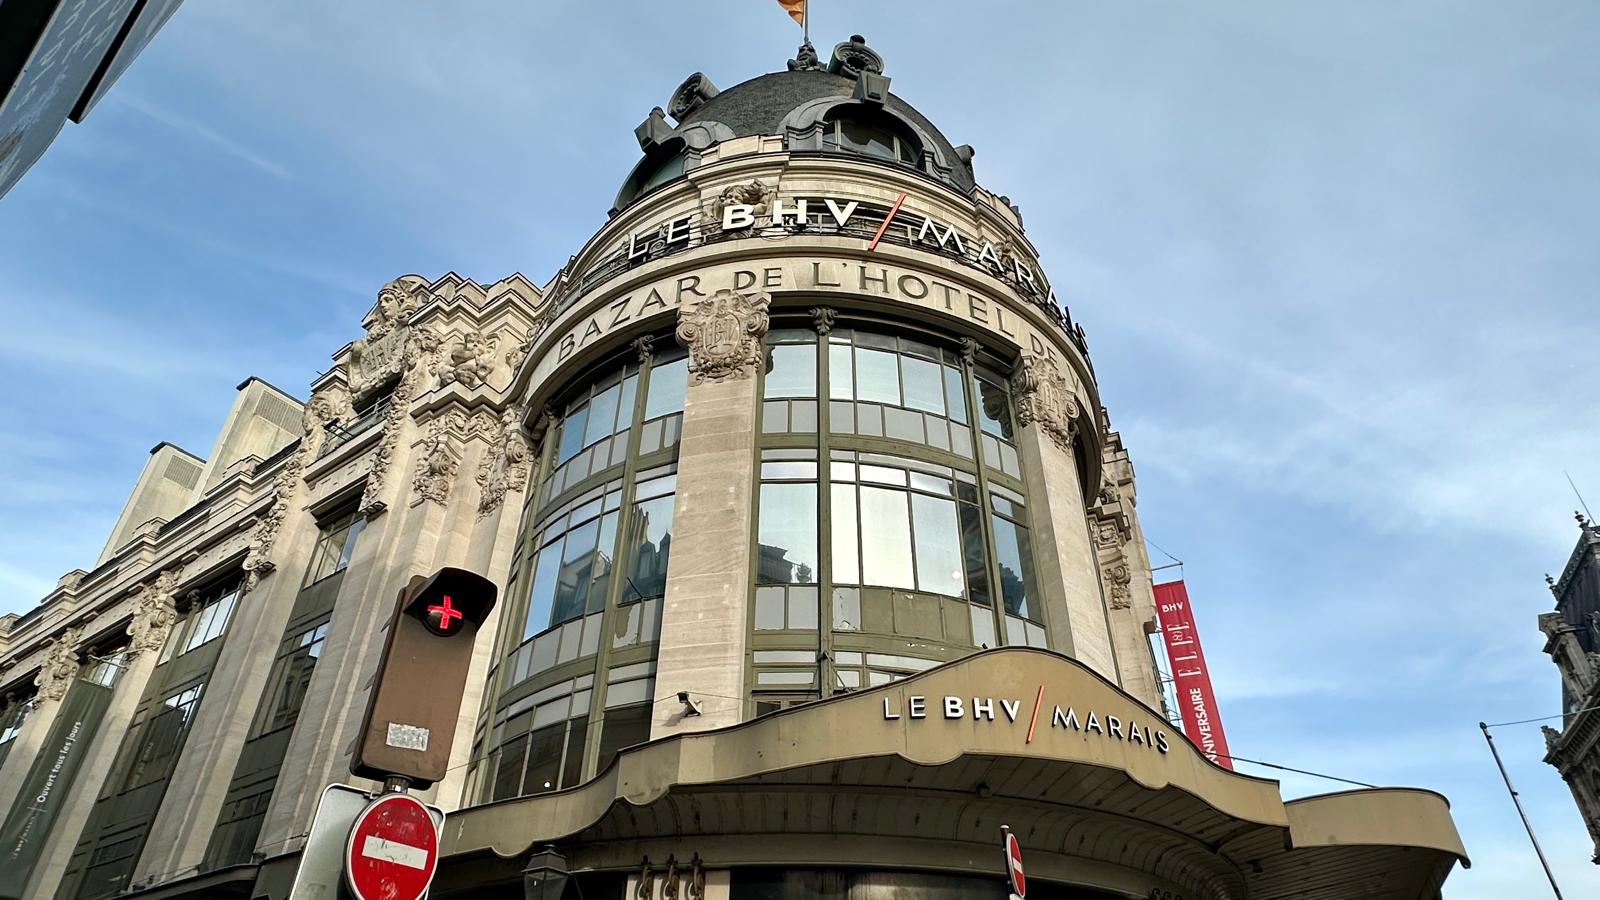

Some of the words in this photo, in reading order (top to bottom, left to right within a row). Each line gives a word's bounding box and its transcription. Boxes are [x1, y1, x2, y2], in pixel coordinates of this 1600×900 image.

[626, 217, 692, 261] LE
[722, 199, 859, 231] BHV
[558, 275, 706, 360] BAZAR
[733, 267, 782, 291] DE
[1161, 601, 1184, 613] BHV
[1166, 621, 1202, 678] ELLE
[883, 695, 927, 721] LE
[943, 695, 1021, 722] BHV
[1051, 705, 1170, 755] MARAIS
[1189, 687, 1220, 765] NNIVERSAIRE
[36, 774, 57, 803] Ouvert
[52, 752, 66, 773] tous
[62, 740, 72, 755] les
